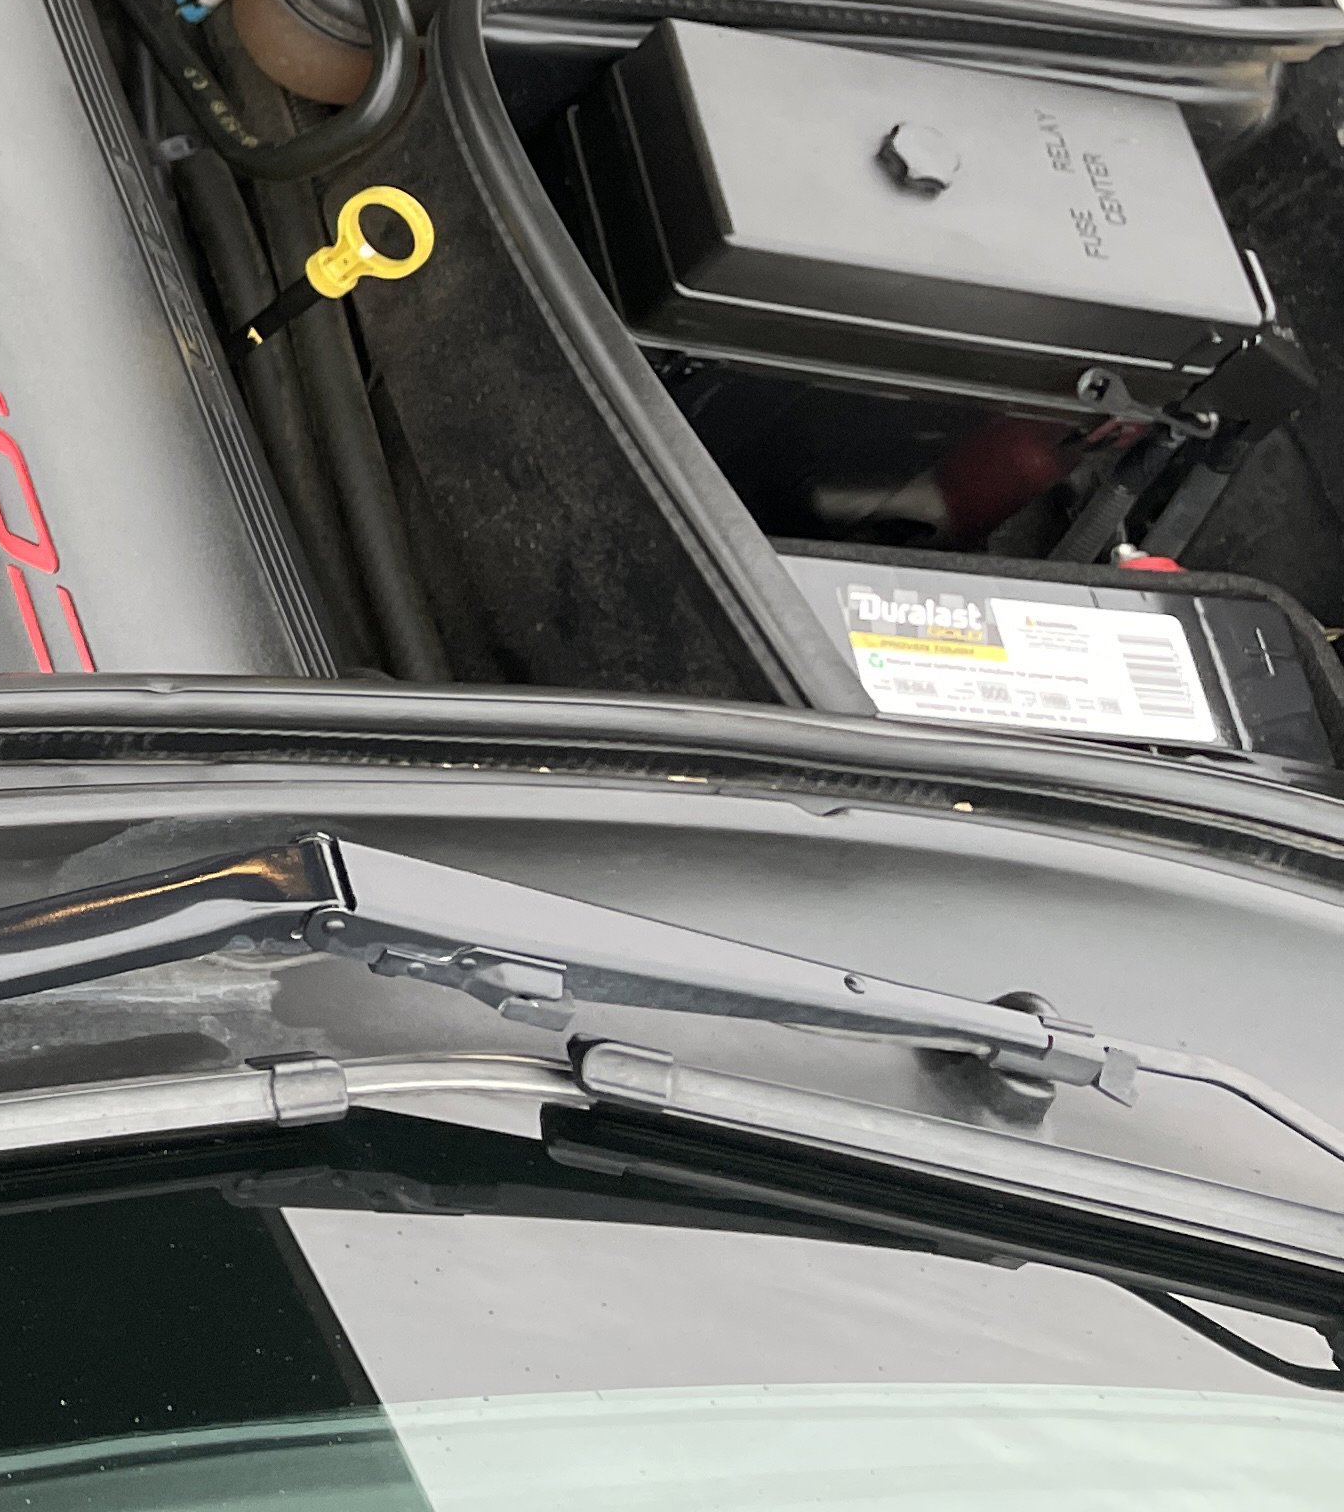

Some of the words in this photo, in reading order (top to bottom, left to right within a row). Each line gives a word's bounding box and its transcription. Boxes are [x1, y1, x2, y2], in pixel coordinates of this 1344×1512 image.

[1034, 108, 1075, 174] RELAY
[1082, 152, 1127, 226] CENTER
[1069, 207, 1109, 260] FUSE
[849, 591, 983, 631] Duralast
